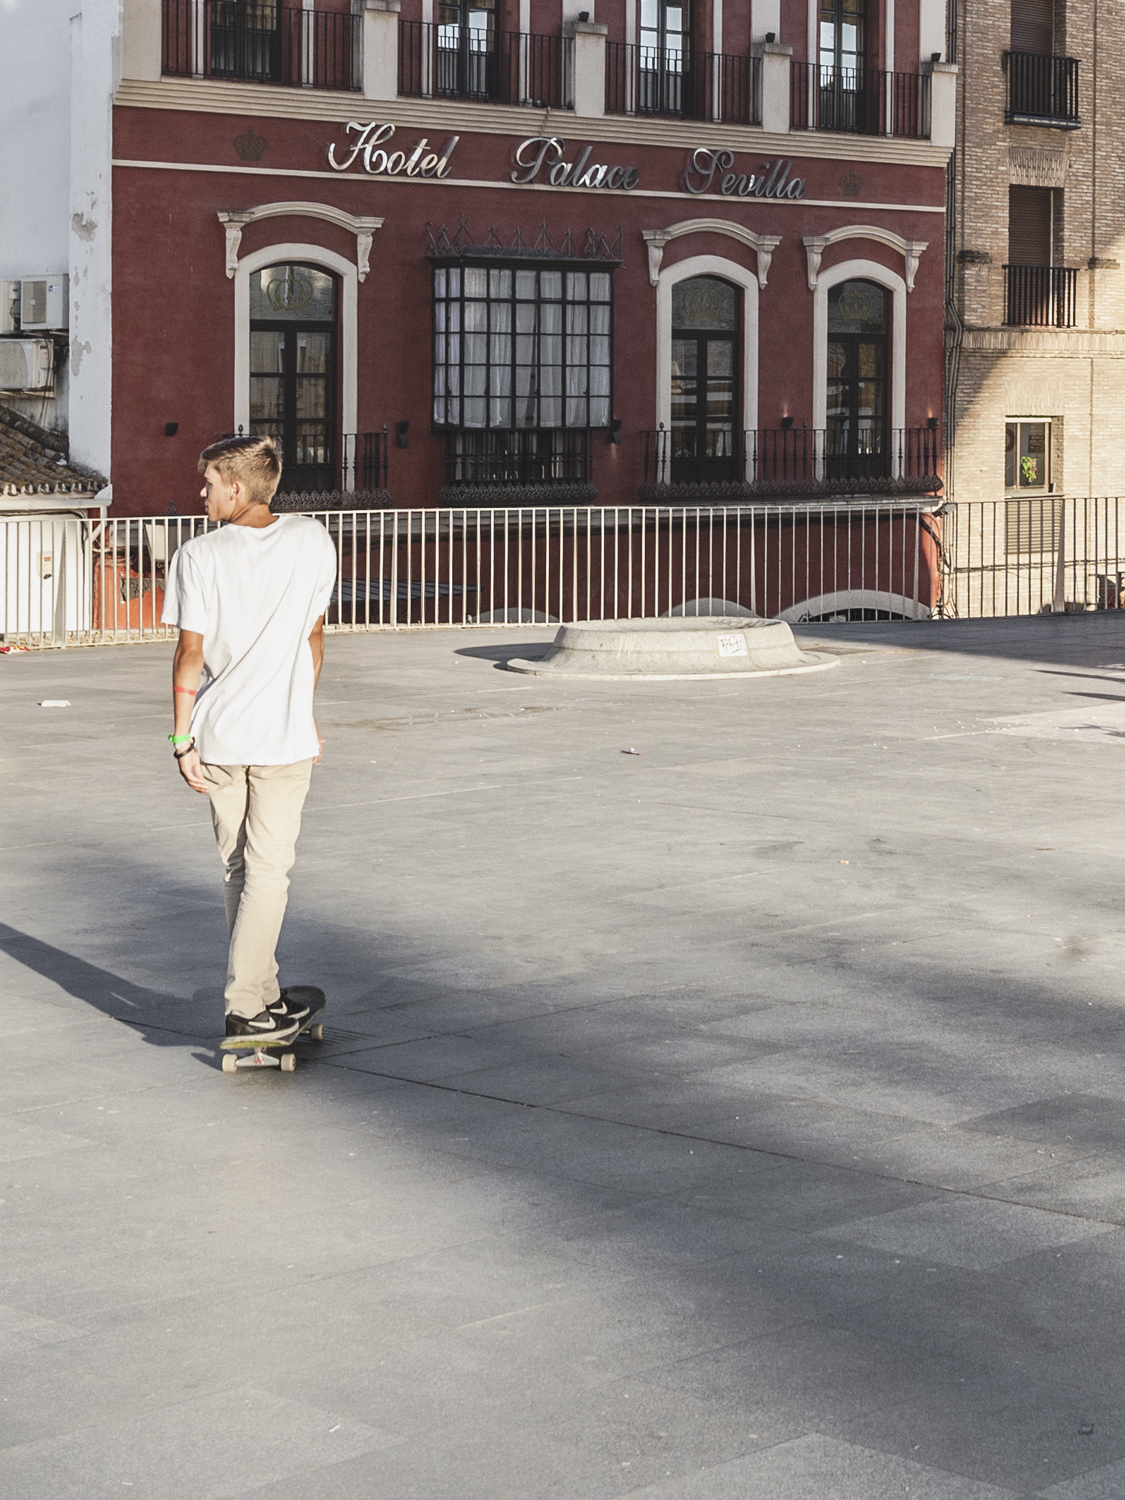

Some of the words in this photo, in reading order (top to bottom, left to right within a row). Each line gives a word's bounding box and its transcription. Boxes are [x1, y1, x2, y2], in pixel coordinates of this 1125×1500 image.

[327, 121, 460, 178] Hotel
[510, 136, 640, 190] Palace
[683, 147, 806, 199] Sevilla
